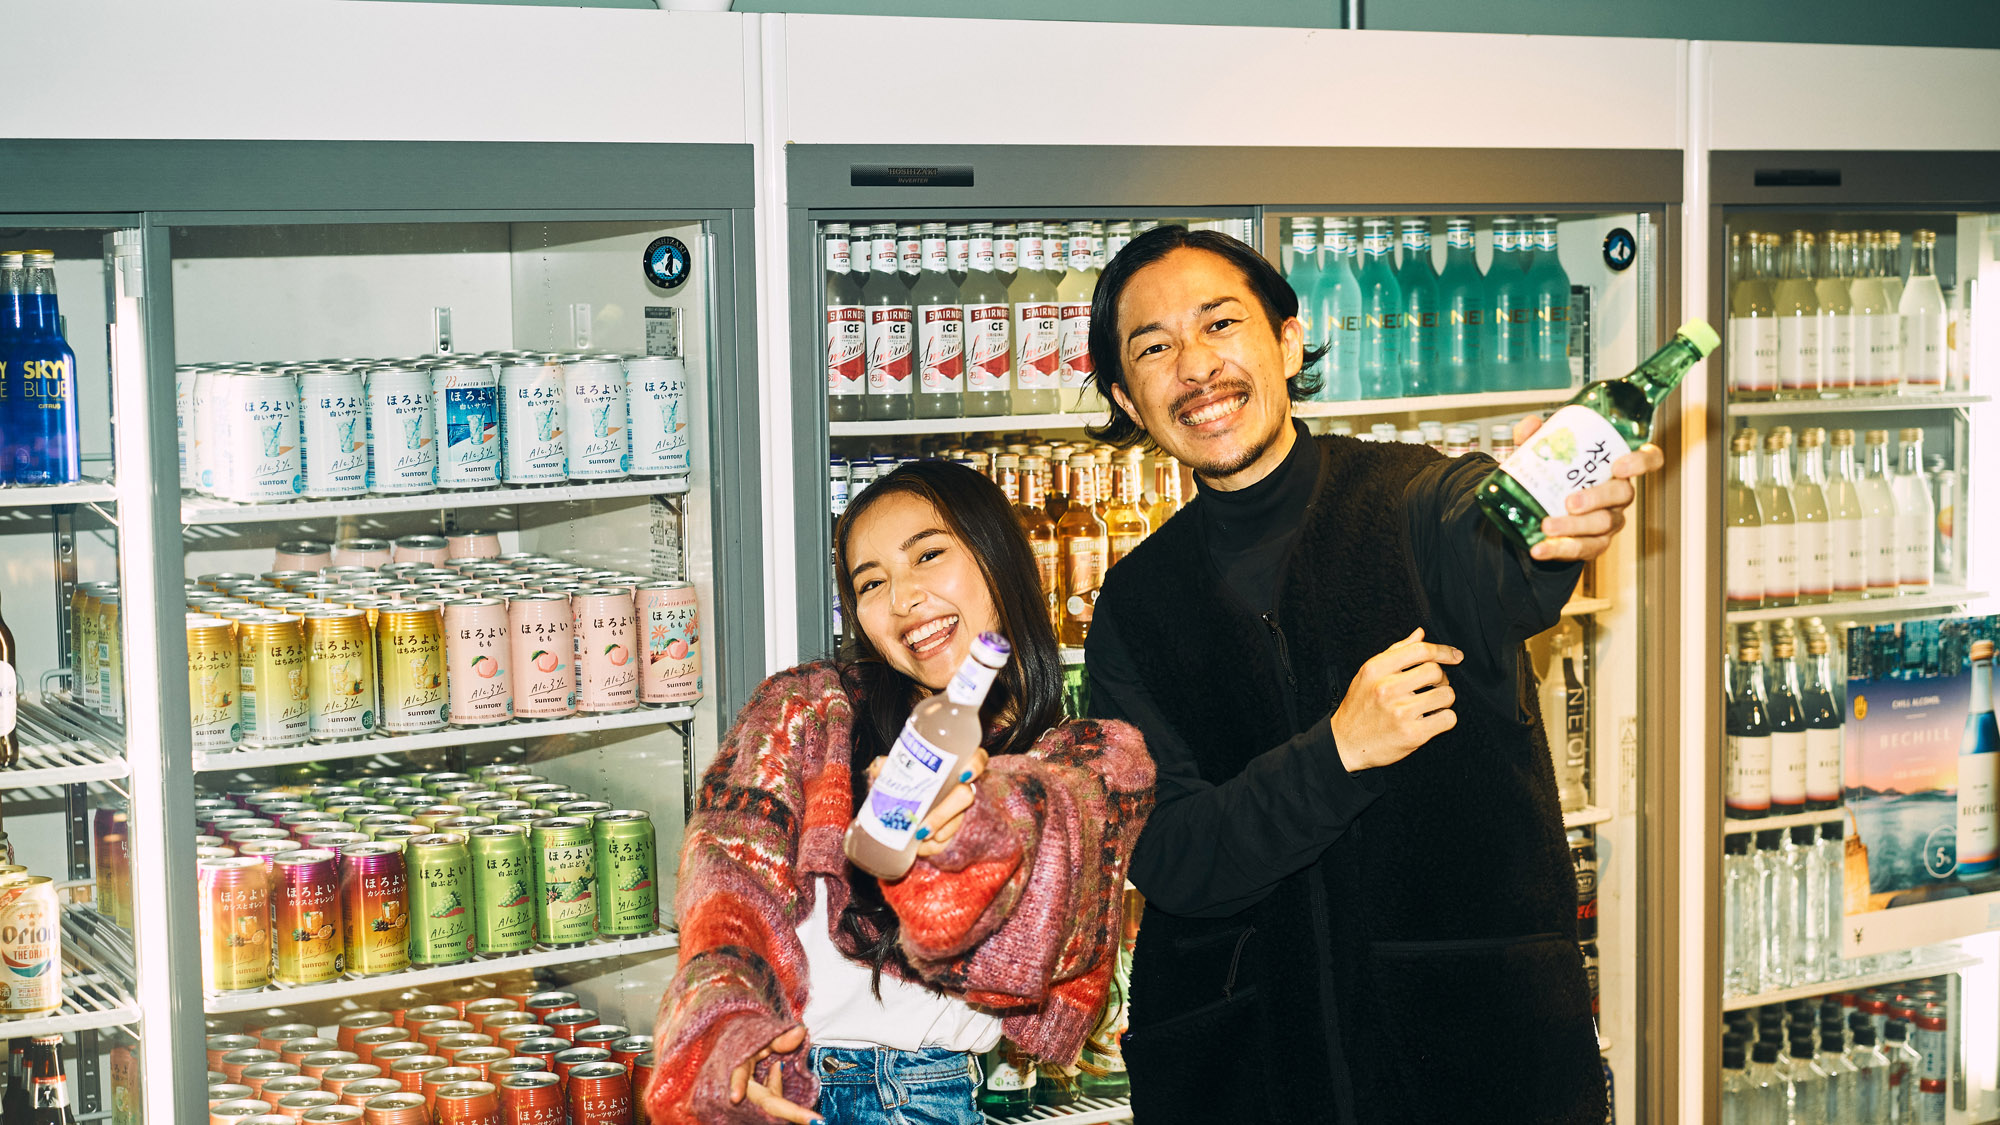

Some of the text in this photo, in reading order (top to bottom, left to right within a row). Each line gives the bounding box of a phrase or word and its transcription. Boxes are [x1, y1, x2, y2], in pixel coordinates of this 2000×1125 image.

[844, 324, 859, 332] ICE
[890, 325, 905, 333] ICE
[943, 324, 957, 332] ICE
[1040, 321, 1054, 329] ICE
[24, 381, 67, 397] BLUE
[575, 384, 621, 395] ほろよい
[645, 380, 686, 392] ほろよい
[450, 390, 495, 402] ほろよい
[519, 387, 563, 398] ほろよい
[245, 400, 294, 412] ほろよい
[321, 397, 365, 409] ほろよい
[387, 394, 432, 406] ほろよい
[1586, 440, 1611, 473] 참
[653, 609, 696, 621] ほろよい
[521, 622, 568, 634] ほろよい
[594, 616, 635, 628] ほろよい
[461, 627, 506, 639] ほろよい
[394, 634, 441, 646] ほろよい
[1879, 728, 1952, 748] BECHILL
[549, 847, 592, 861] ほろよい
[487, 855, 531, 869] ほろよい
[420, 866, 466, 879] ほろよい
[287, 883, 335, 898] ほろよい
[623, 913, 648, 921] SUNTORY
[563, 921, 588, 929] SUNTORY
[434, 941, 461, 949] SUNTORY
[13, 950, 27, 960] THE
[584, 1097, 628, 1110] ほろよい
[520, 1106, 562, 1120] ほろよい
